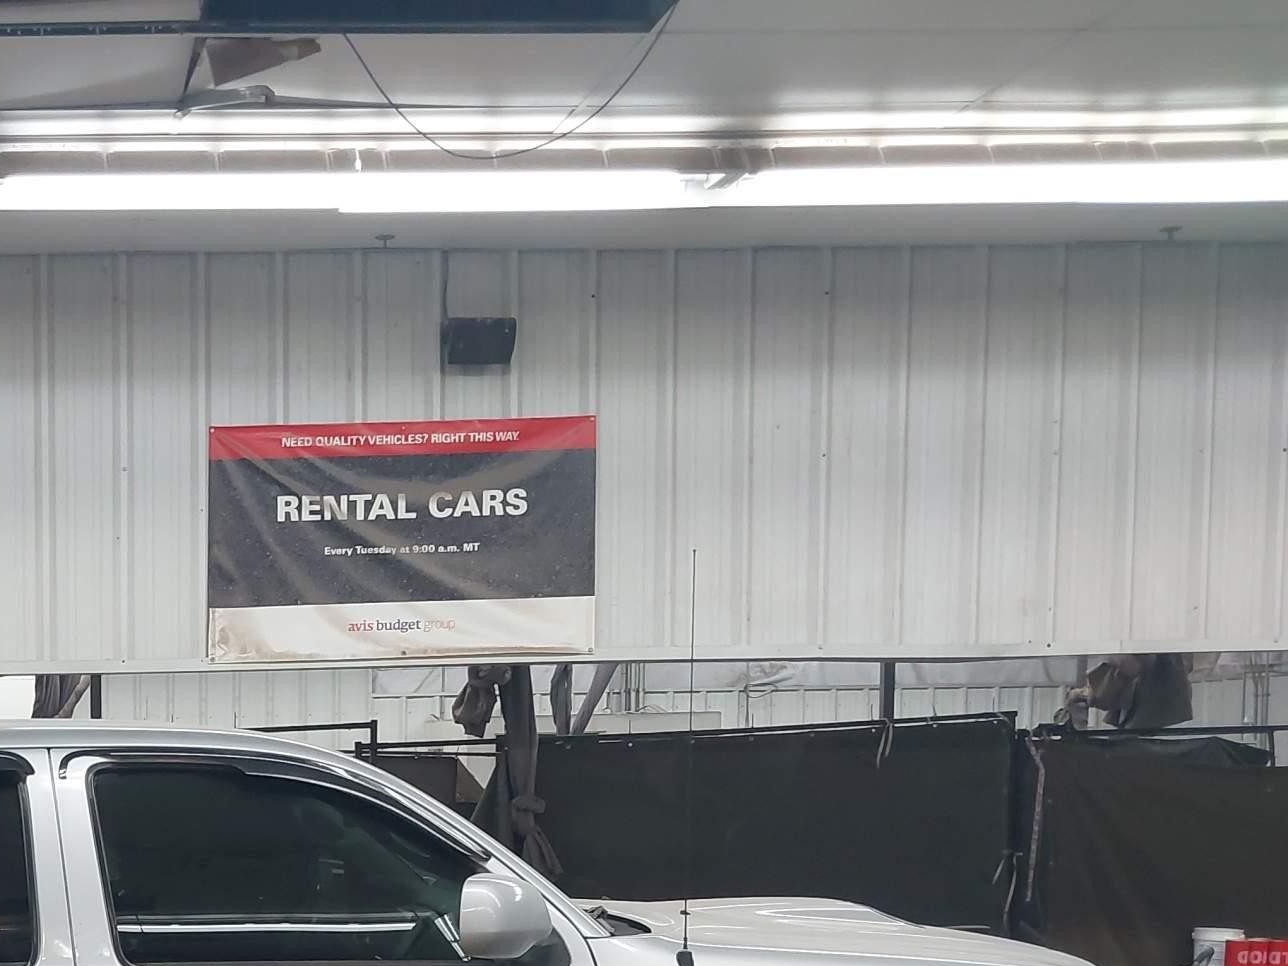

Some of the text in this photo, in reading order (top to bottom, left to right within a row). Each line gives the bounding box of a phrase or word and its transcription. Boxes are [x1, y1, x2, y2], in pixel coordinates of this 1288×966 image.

[281, 431, 520, 448] NEED QUALITY VEHICLES? RIGHT THIS WAY.
[276, 488, 528, 522] RENTAL CARS
[324, 546, 353, 557] Every
[354, 545, 397, 556] Tuesday
[399, 546, 410, 554] at
[412, 545, 436, 553] 9:00
[463, 542, 481, 552] MT
[348, 618, 456, 633] avis budget group
